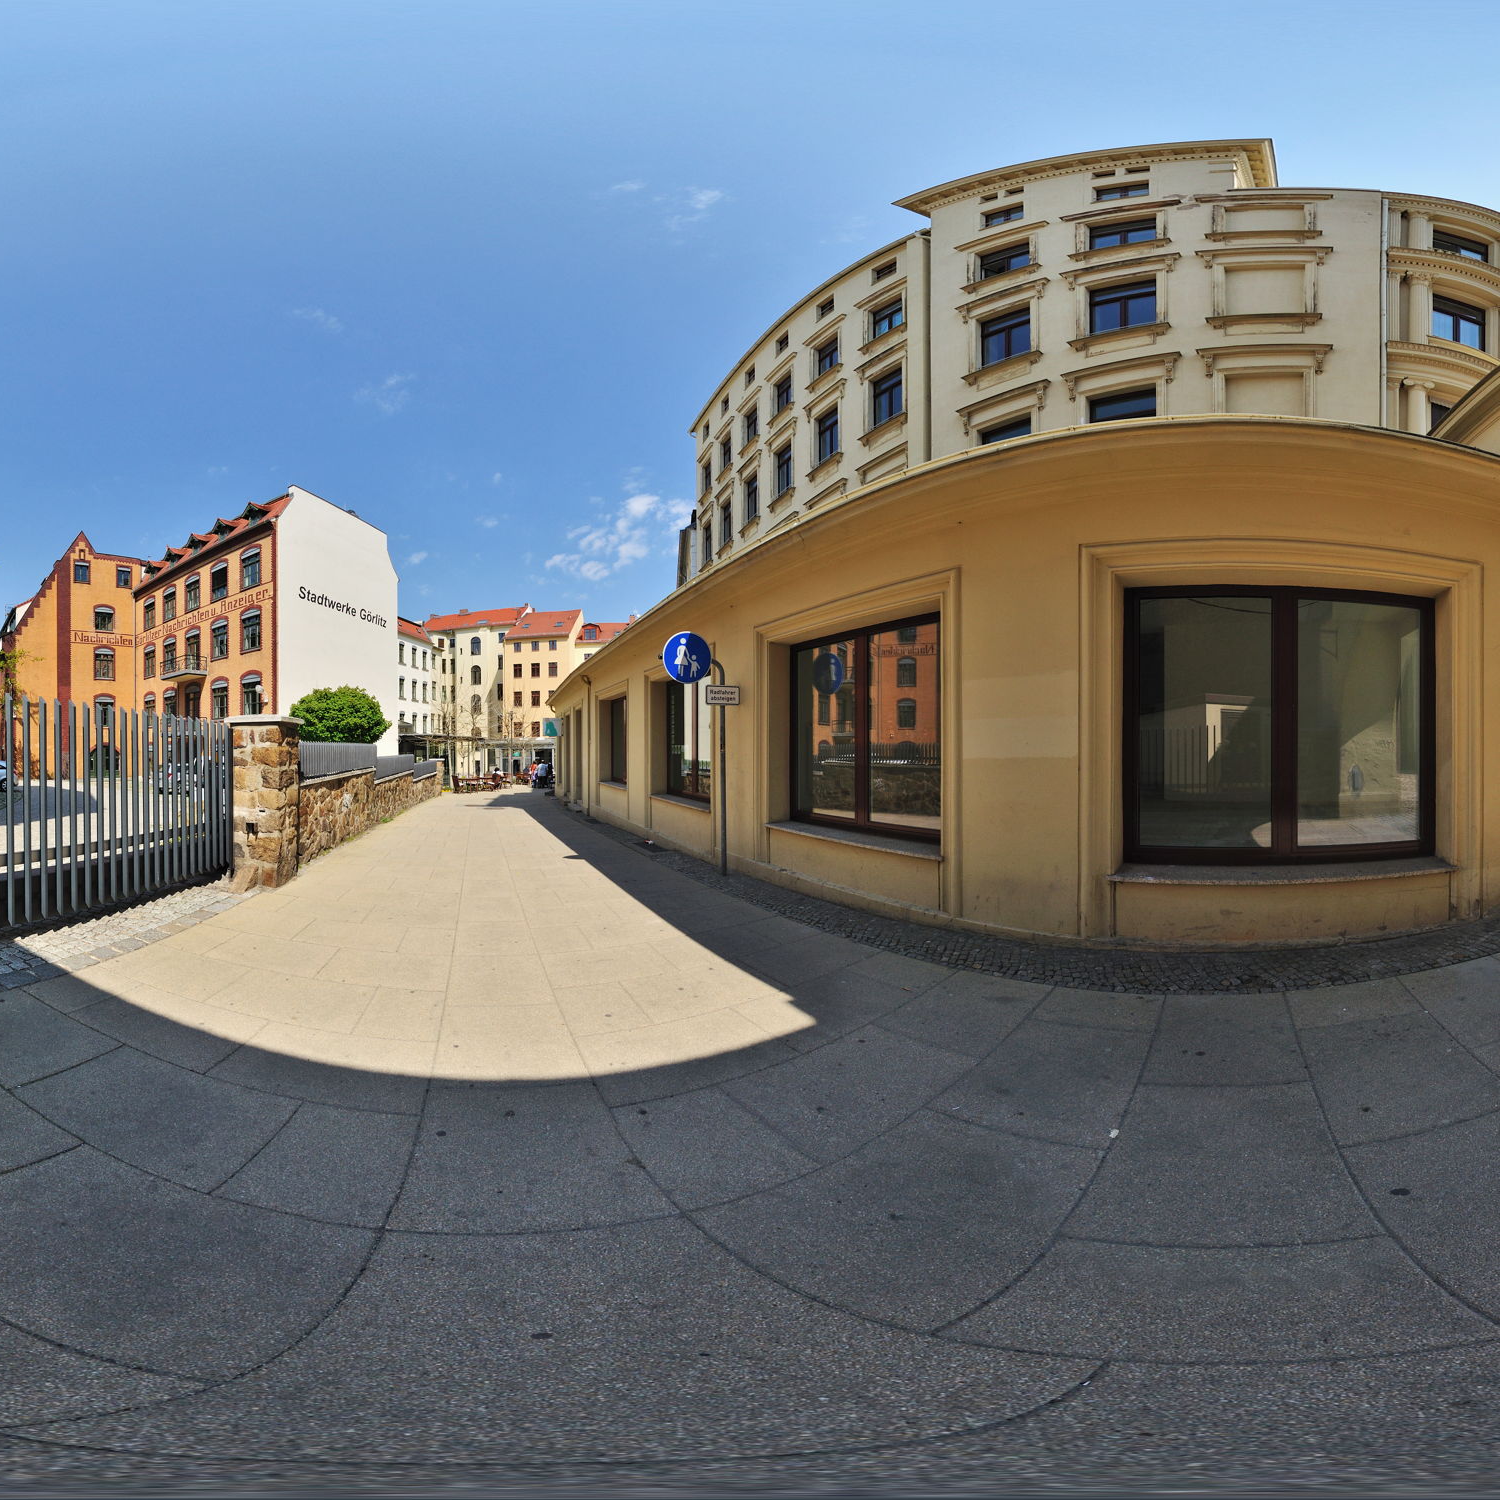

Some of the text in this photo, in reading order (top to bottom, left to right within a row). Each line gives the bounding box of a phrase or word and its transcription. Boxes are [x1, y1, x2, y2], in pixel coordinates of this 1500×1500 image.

[298, 586, 387, 628] Stadtwerke Görlitz
[162, 611, 210, 634] Nachrichten
[74, 632, 133, 645] Nachrichten
